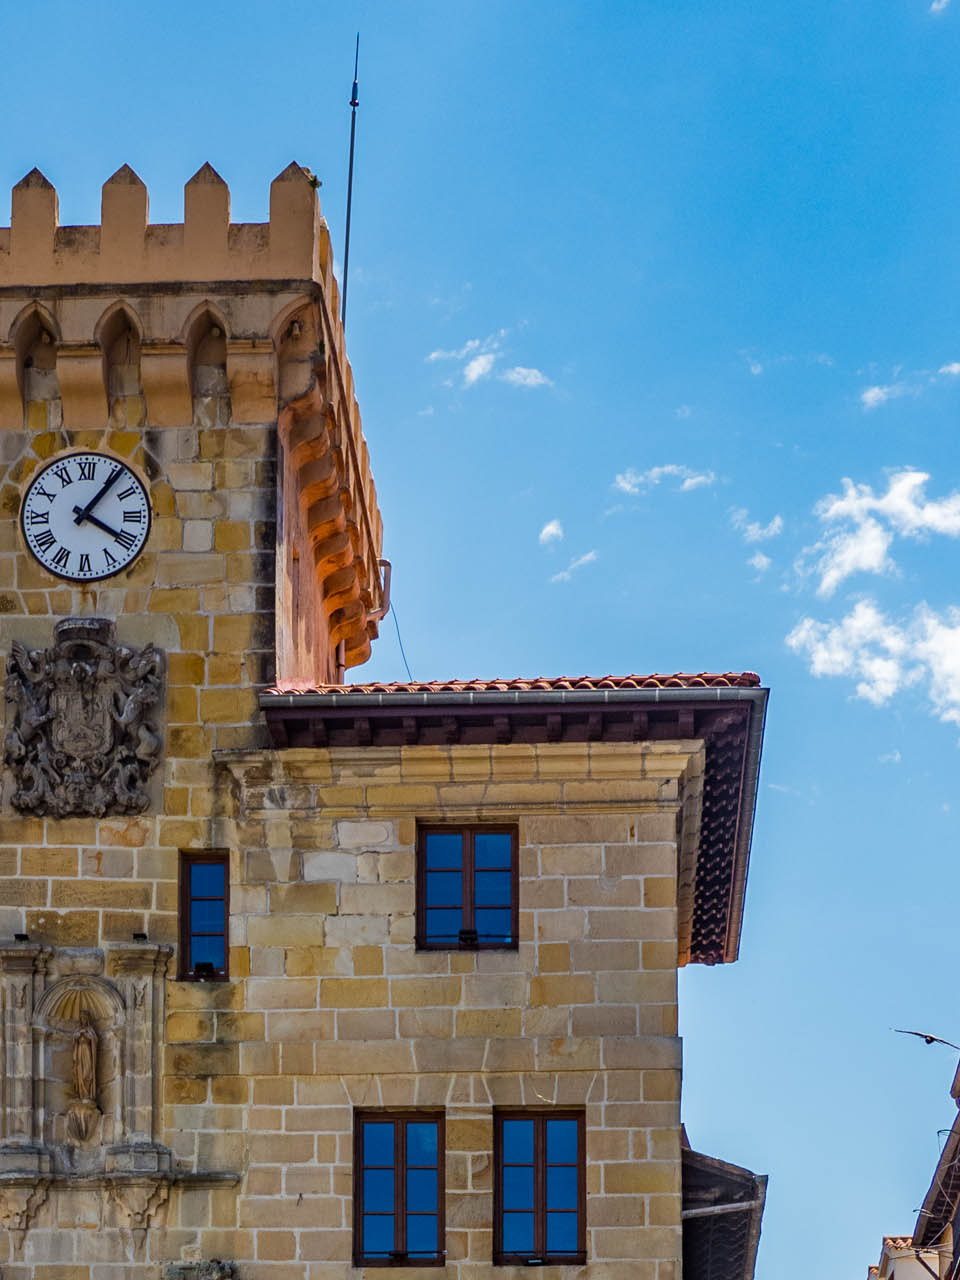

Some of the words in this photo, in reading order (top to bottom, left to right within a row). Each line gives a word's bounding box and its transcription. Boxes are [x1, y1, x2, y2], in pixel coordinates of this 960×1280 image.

[53, 467, 74, 488] XI
[77, 462, 97, 480] XII
[36, 485, 57, 503] X
[117, 485, 137, 502] II
[31, 509, 49, 525] IX
[123, 510, 141, 523] III
[33, 528, 57, 554] VIII
[51, 546, 72, 569] VII
[79, 554, 92, 572] VI
[102, 548, 118, 567] V
